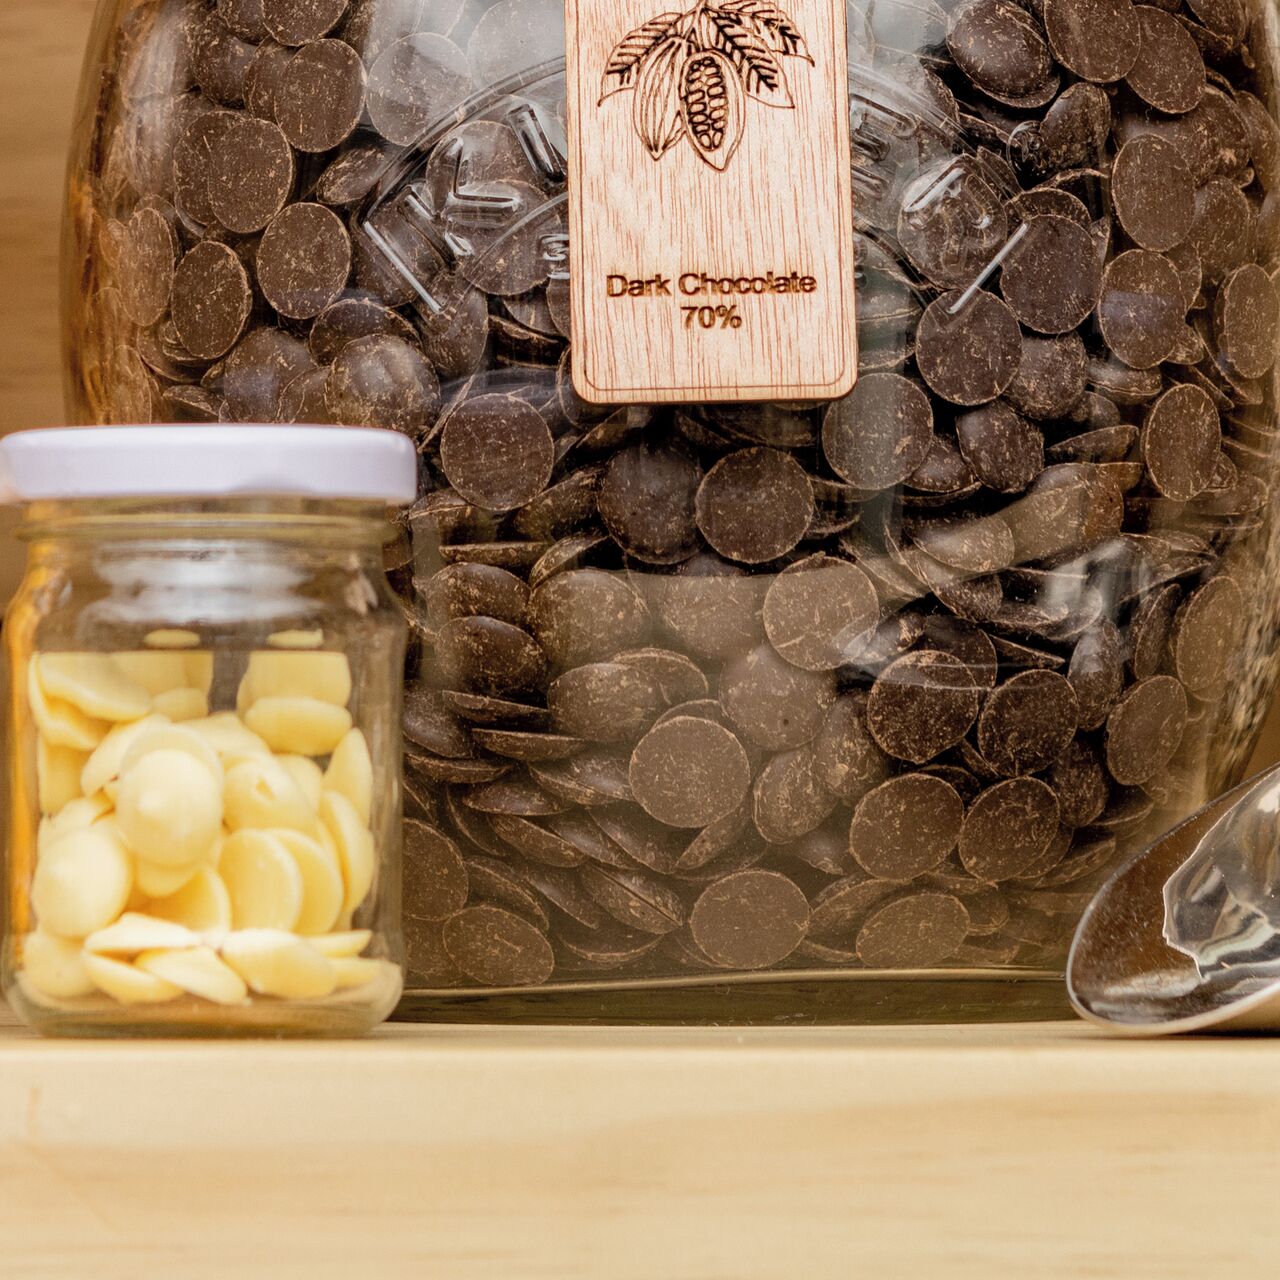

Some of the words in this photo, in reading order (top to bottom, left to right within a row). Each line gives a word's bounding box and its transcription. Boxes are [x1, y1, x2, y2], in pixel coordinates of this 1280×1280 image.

[606, 272, 672, 297] Dark
[677, 270, 818, 297] Chocolate
[680, 304, 743, 330] 70%
